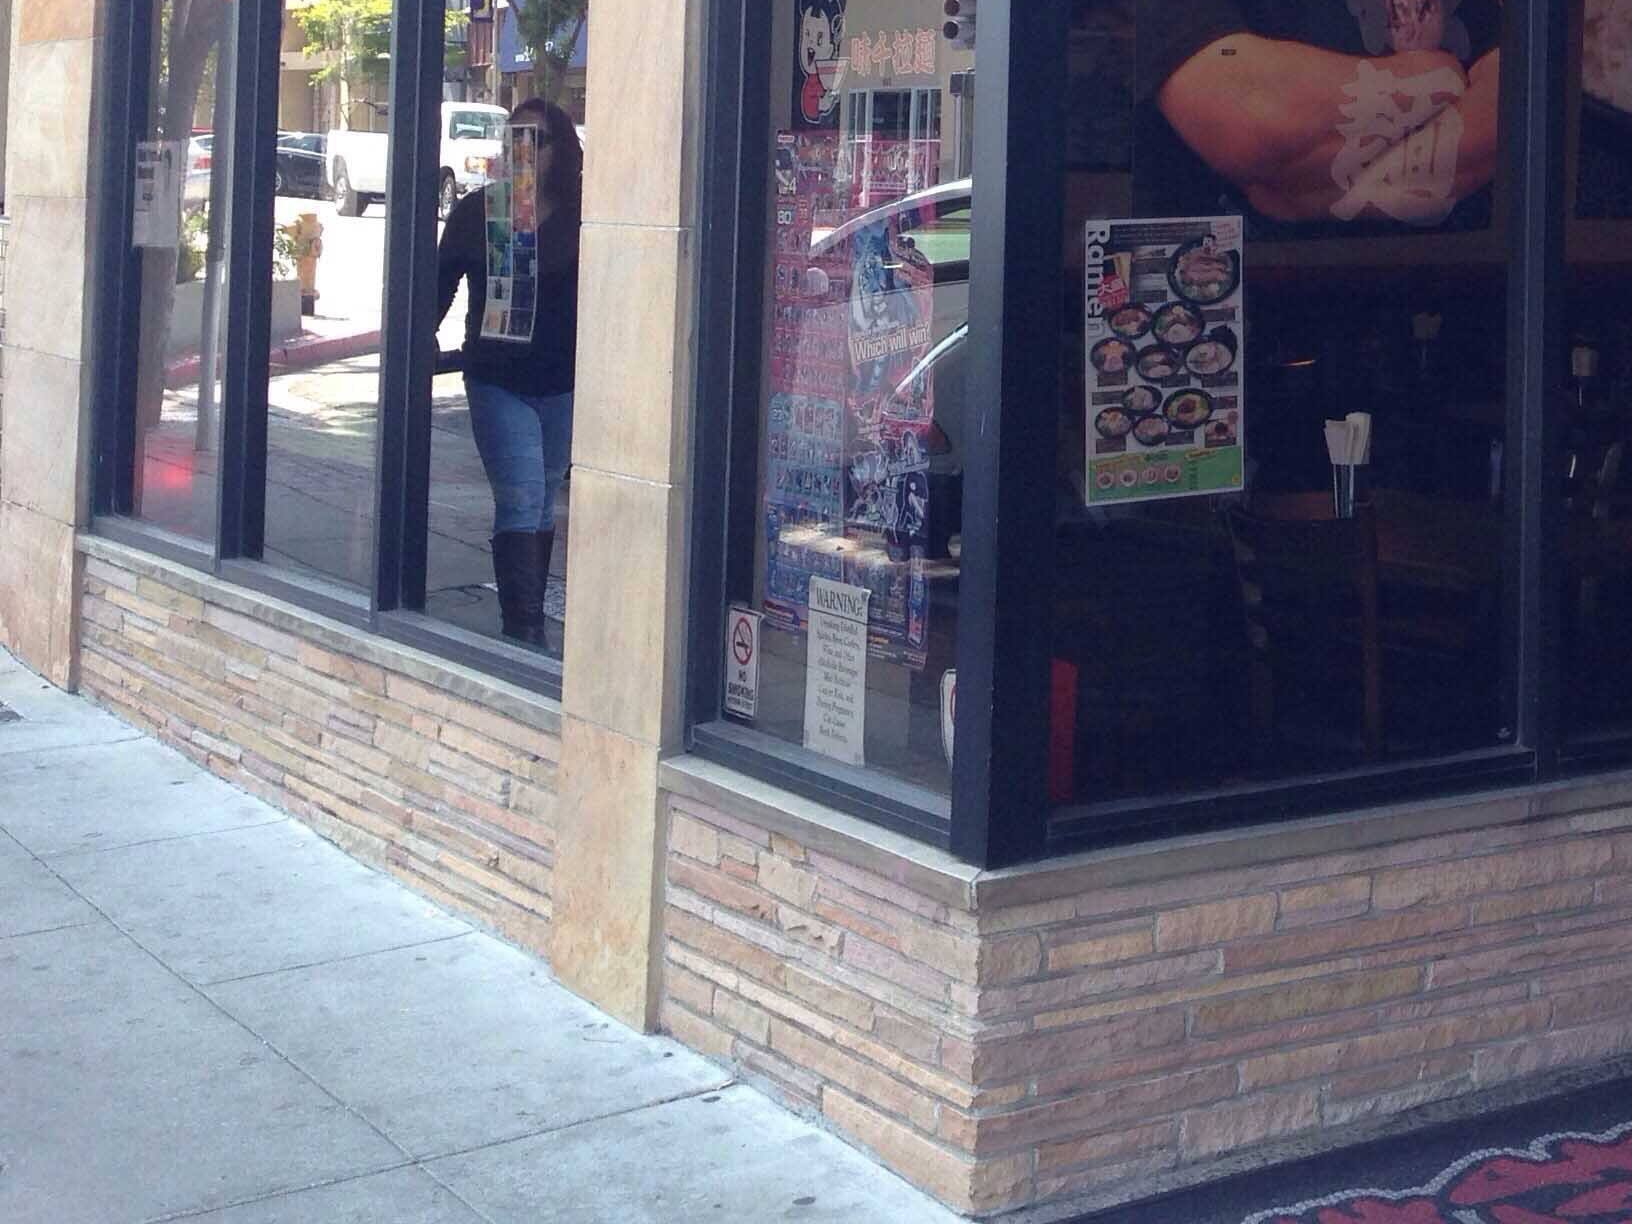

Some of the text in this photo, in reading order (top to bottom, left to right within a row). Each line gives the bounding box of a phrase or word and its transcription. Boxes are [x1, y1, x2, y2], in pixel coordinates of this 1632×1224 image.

[1087, 220, 1111, 338] Ramen
[855, 337, 888, 361] Which
[889, 328, 908, 353] will
